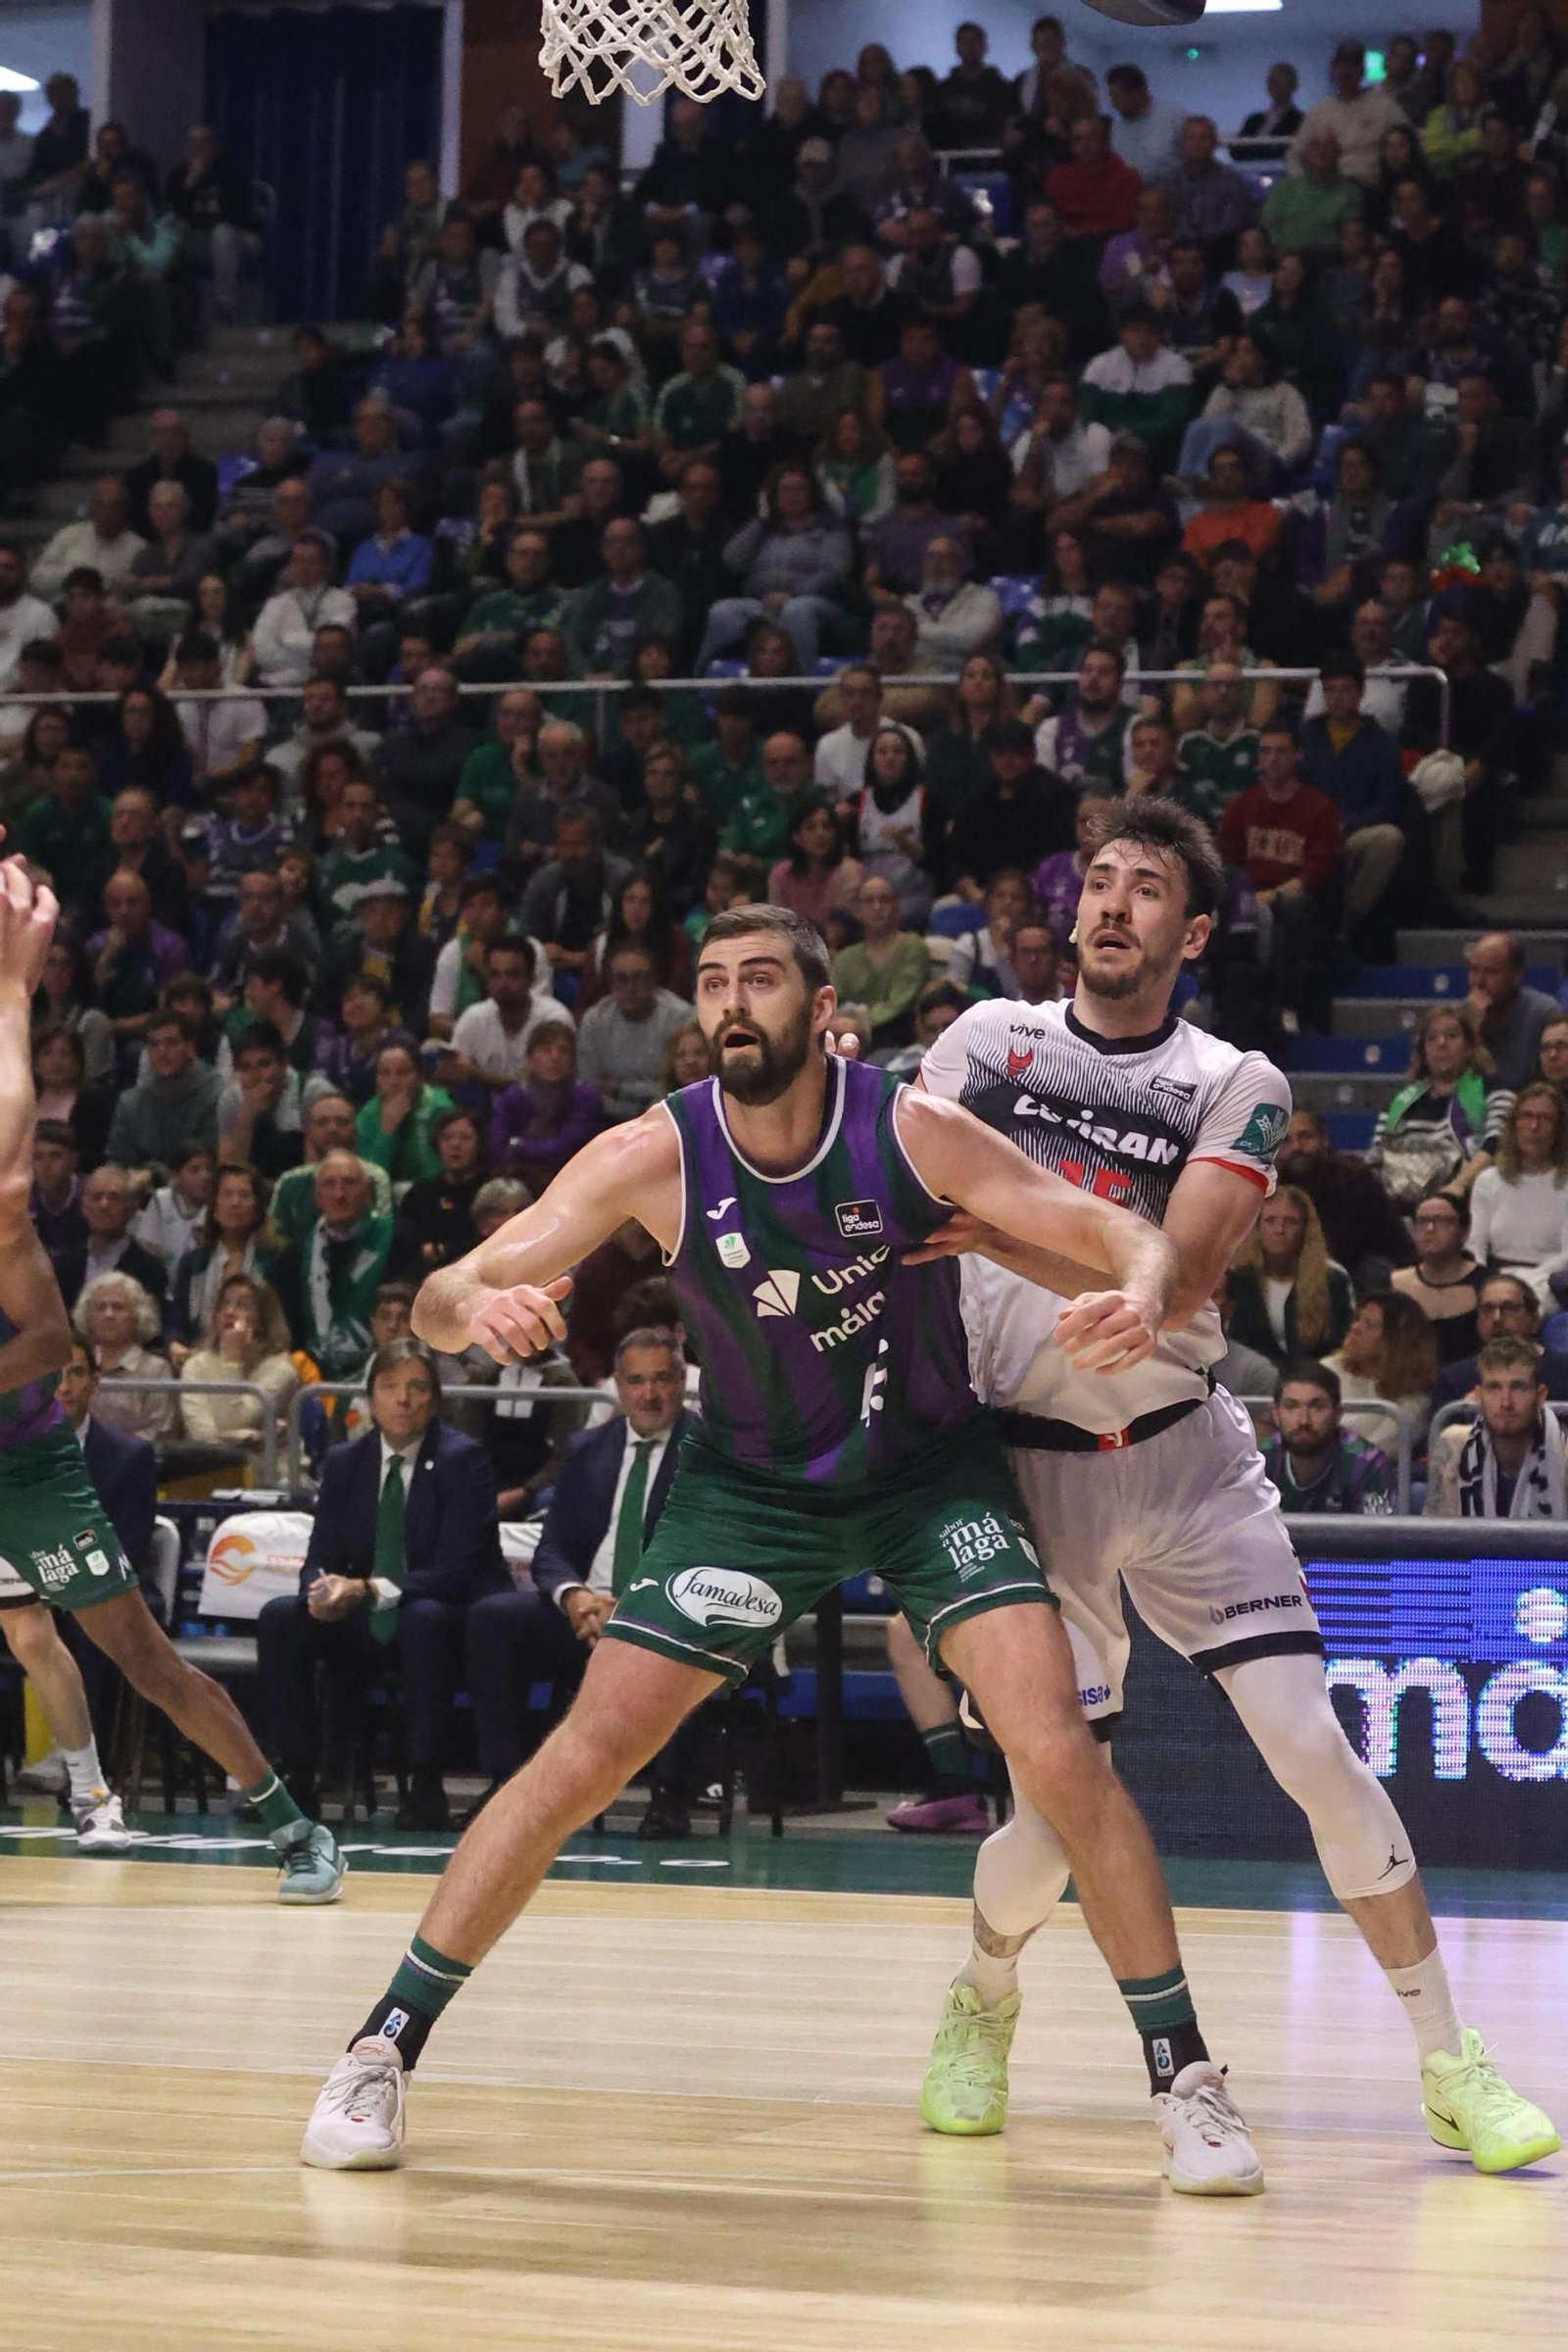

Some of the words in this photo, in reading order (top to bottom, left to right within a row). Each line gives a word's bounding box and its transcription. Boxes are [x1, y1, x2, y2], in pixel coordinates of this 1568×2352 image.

[1010, 1023, 1046, 1040] vive
[842, 1212, 860, 1224] liga
[845, 1220, 880, 1232] endesa
[939, 1518, 963, 1540] sabor
[950, 1511, 1004, 1548] má
[948, 1534, 1010, 1571] laga
[37, 1562, 80, 1584] laga
[675, 1569, 778, 1616] famadesa
[1224, 1594, 1303, 1619] BERNER
